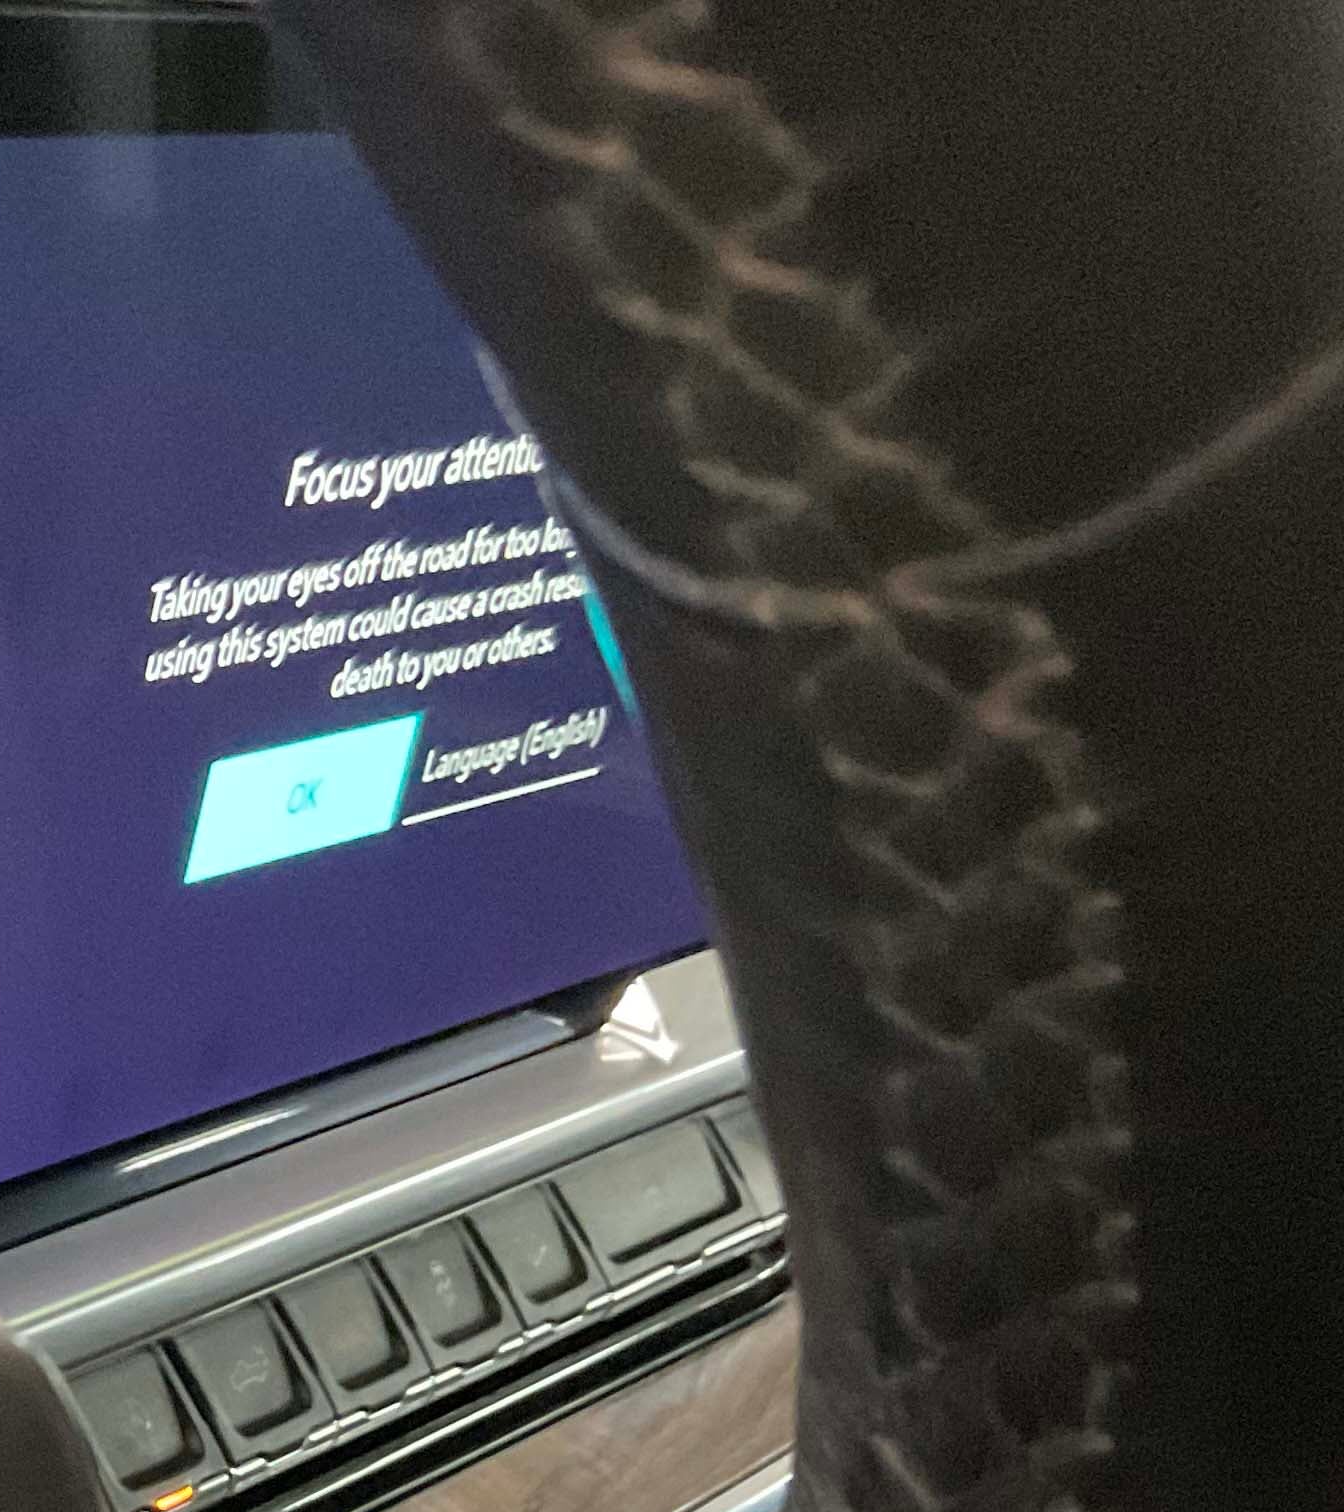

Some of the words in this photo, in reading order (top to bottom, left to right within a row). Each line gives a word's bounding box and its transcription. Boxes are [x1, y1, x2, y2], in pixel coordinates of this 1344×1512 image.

[284, 450, 378, 507] Focus
[370, 451, 446, 509] your
[150, 574, 231, 624] Taking
[225, 570, 290, 621] your
[286, 561, 344, 608] eyes
[343, 541, 387, 588] off
[380, 541, 414, 582] the
[419, 528, 474, 574] road
[471, 525, 506, 565] for
[504, 529, 539, 560] too
[145, 638, 216, 684] using
[218, 623, 262, 668] this
[263, 615, 347, 668] system
[348, 593, 414, 641] could
[412, 591, 469, 629] cause
[472, 590, 489, 617] a
[489, 568, 543, 614] crash
[330, 651, 395, 698] death
[397, 652, 422, 684] to
[416, 648, 462, 690] you
[462, 643, 488, 670] or
[488, 625, 557, 664] others.
[422, 735, 520, 783] Language
[520, 706, 608, 765] (English)
[287, 779, 323, 814] OK
